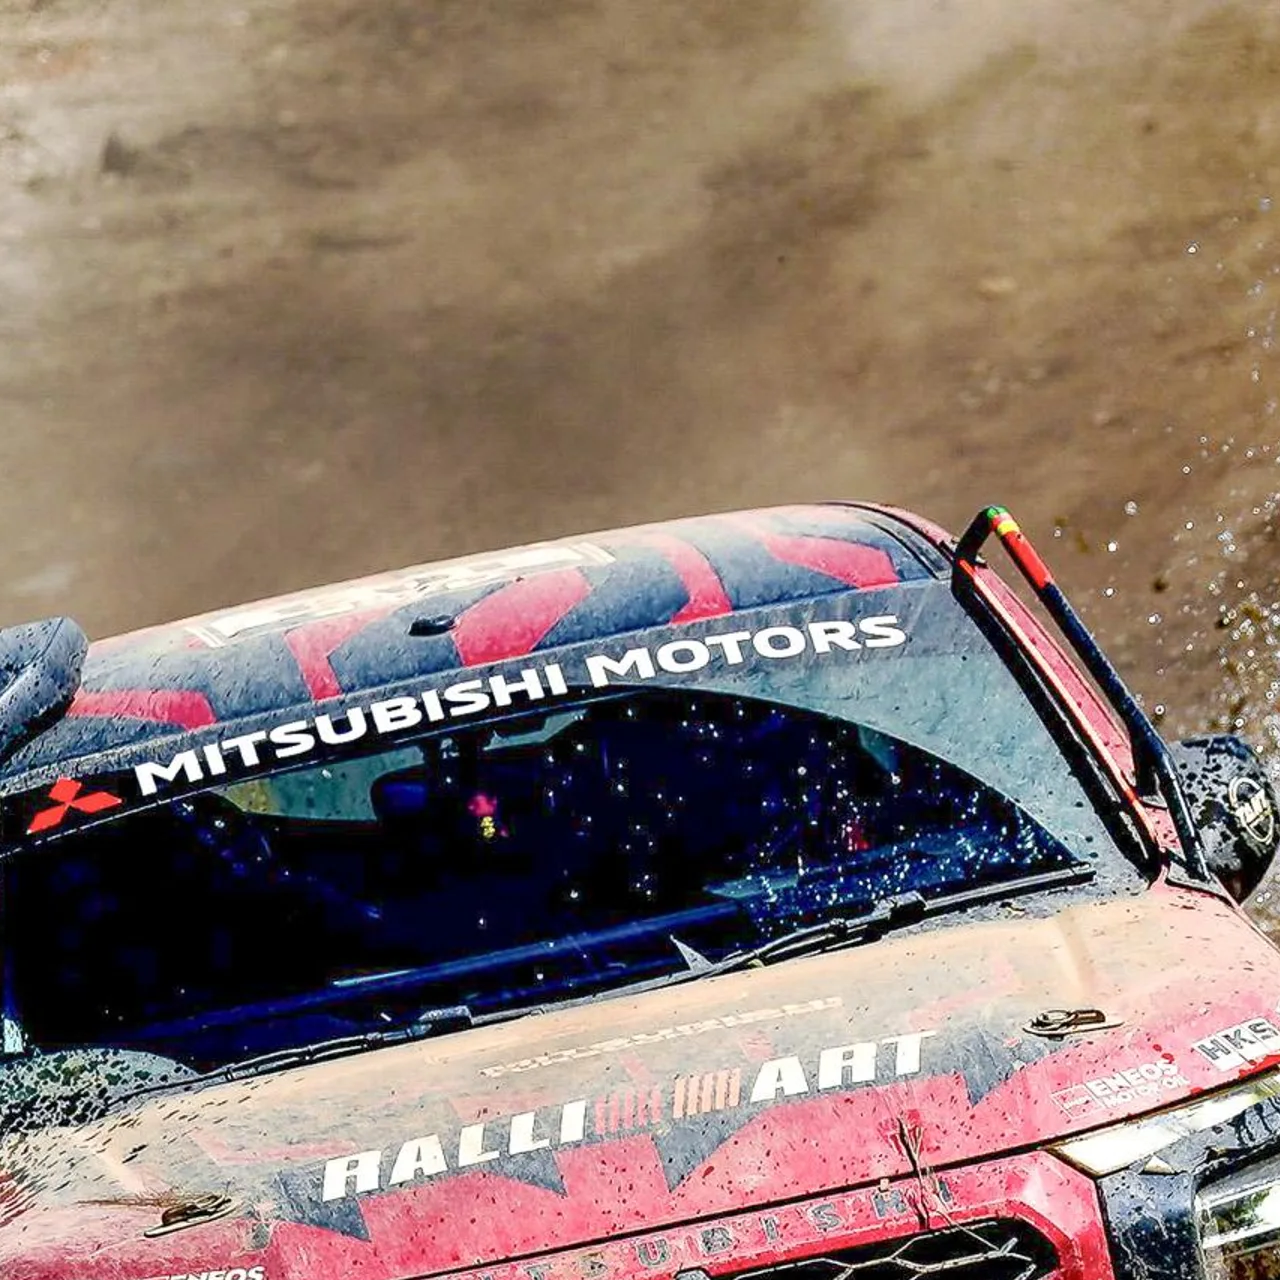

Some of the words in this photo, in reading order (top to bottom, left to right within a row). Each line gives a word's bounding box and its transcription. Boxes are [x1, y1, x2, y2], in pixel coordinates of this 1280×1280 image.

[134, 662, 568, 796] MITSUBISHI
[587, 614, 907, 688] MOTORS
[1086, 1058, 1180, 1097] ENEOS
[1197, 1020, 1279, 1061] HKS
[322, 1099, 587, 1202] RALLI
[750, 1029, 939, 1103] ART
